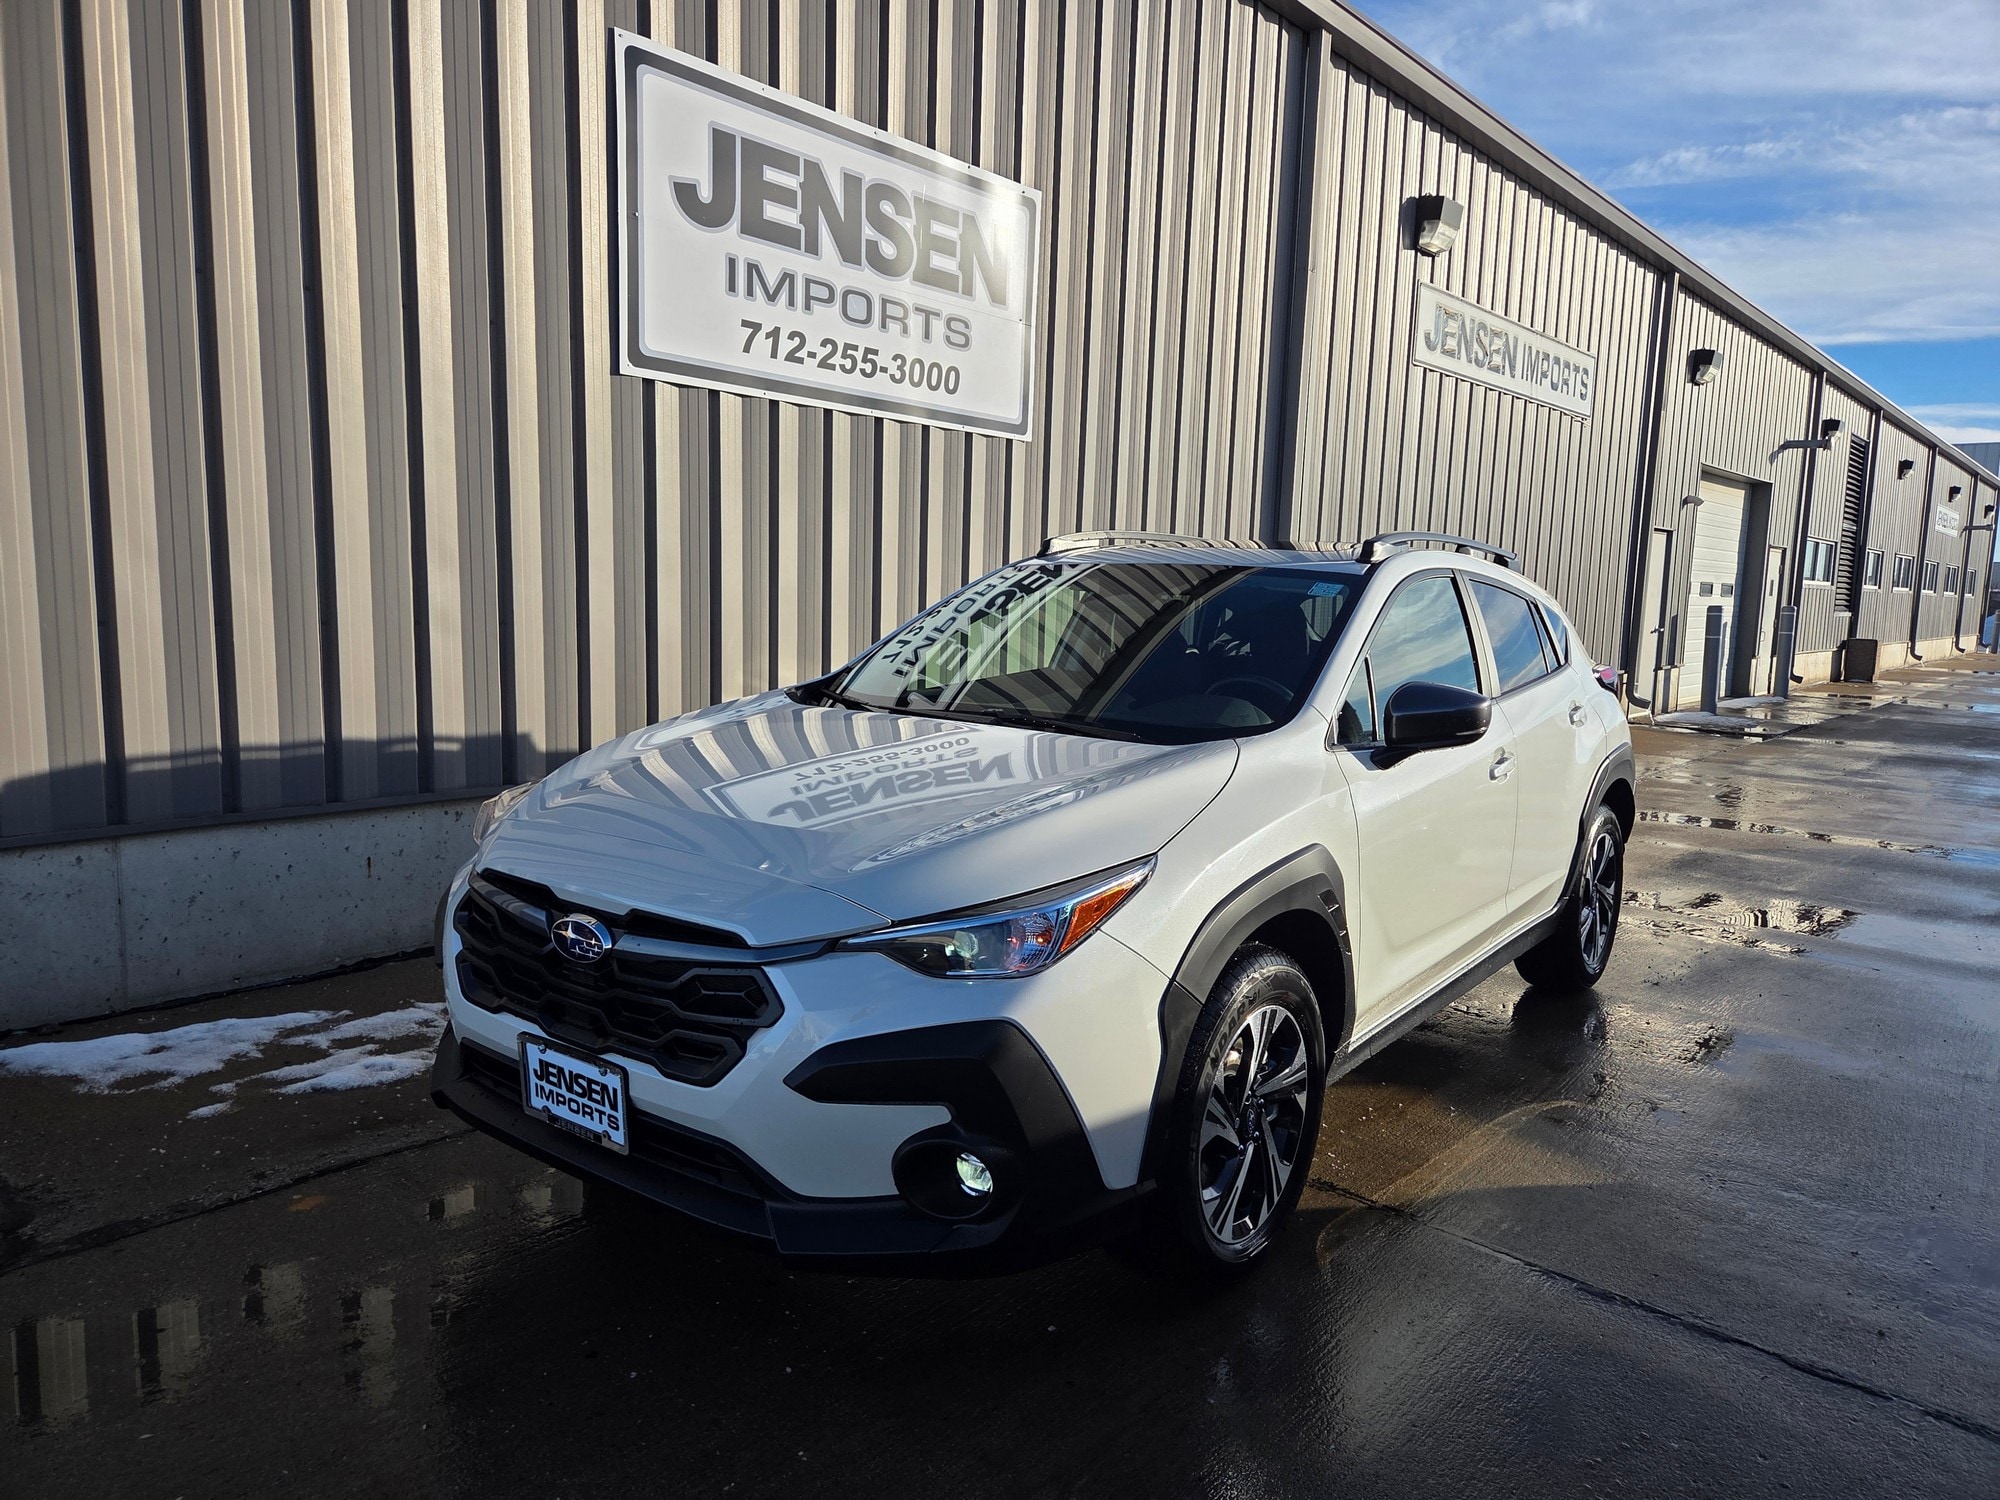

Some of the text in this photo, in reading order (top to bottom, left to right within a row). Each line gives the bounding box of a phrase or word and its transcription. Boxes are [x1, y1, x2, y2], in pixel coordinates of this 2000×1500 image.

[670, 123, 1008, 308] JENSEN
[727, 254, 972, 351] IMPORTS
[739, 318, 961, 396] 712-255-3000
[1423, 302, 1590, 402] JENSEN IMPORTS
[533, 1057, 619, 1113] JENSEN
[534, 1082, 620, 1132] IMPORTS
[555, 1118, 594, 1140] JENSEN
